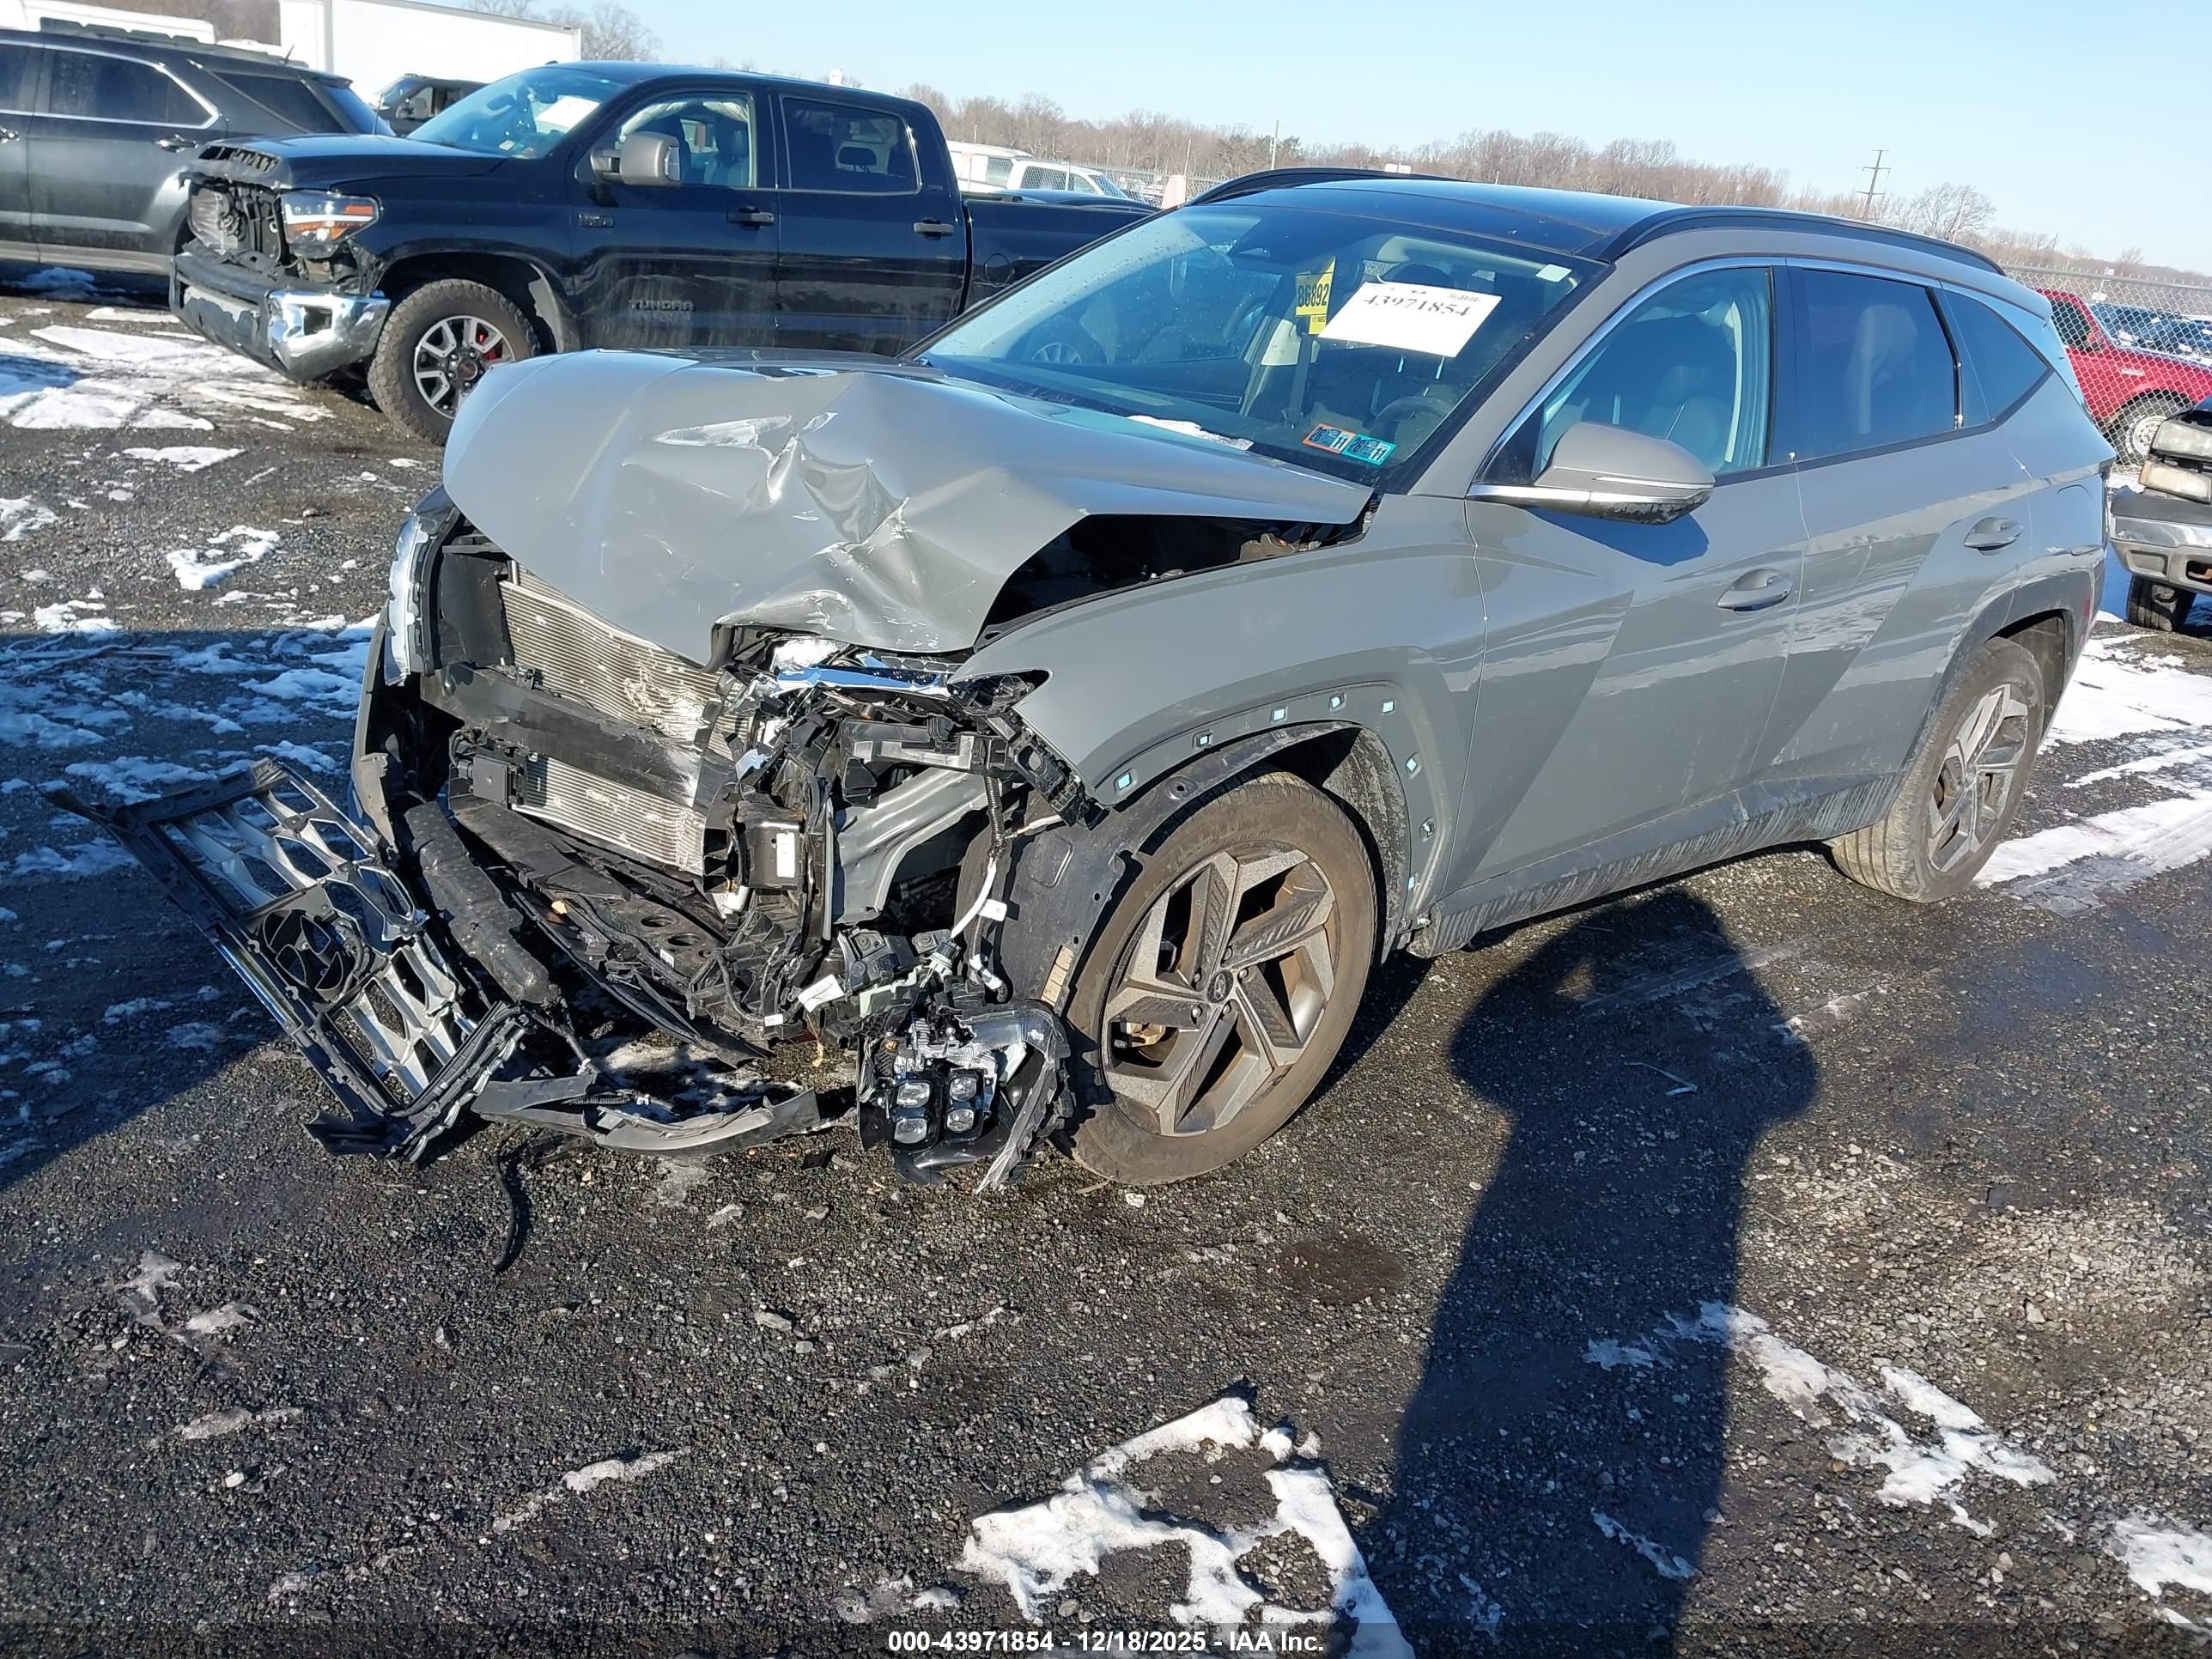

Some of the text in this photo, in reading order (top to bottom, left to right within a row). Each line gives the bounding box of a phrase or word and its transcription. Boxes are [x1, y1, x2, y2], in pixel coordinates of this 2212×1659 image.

[628, 299, 694, 312] TUNDRA
[1297, 283, 1329, 307] 86892
[1363, 295, 1471, 317] 43971854
